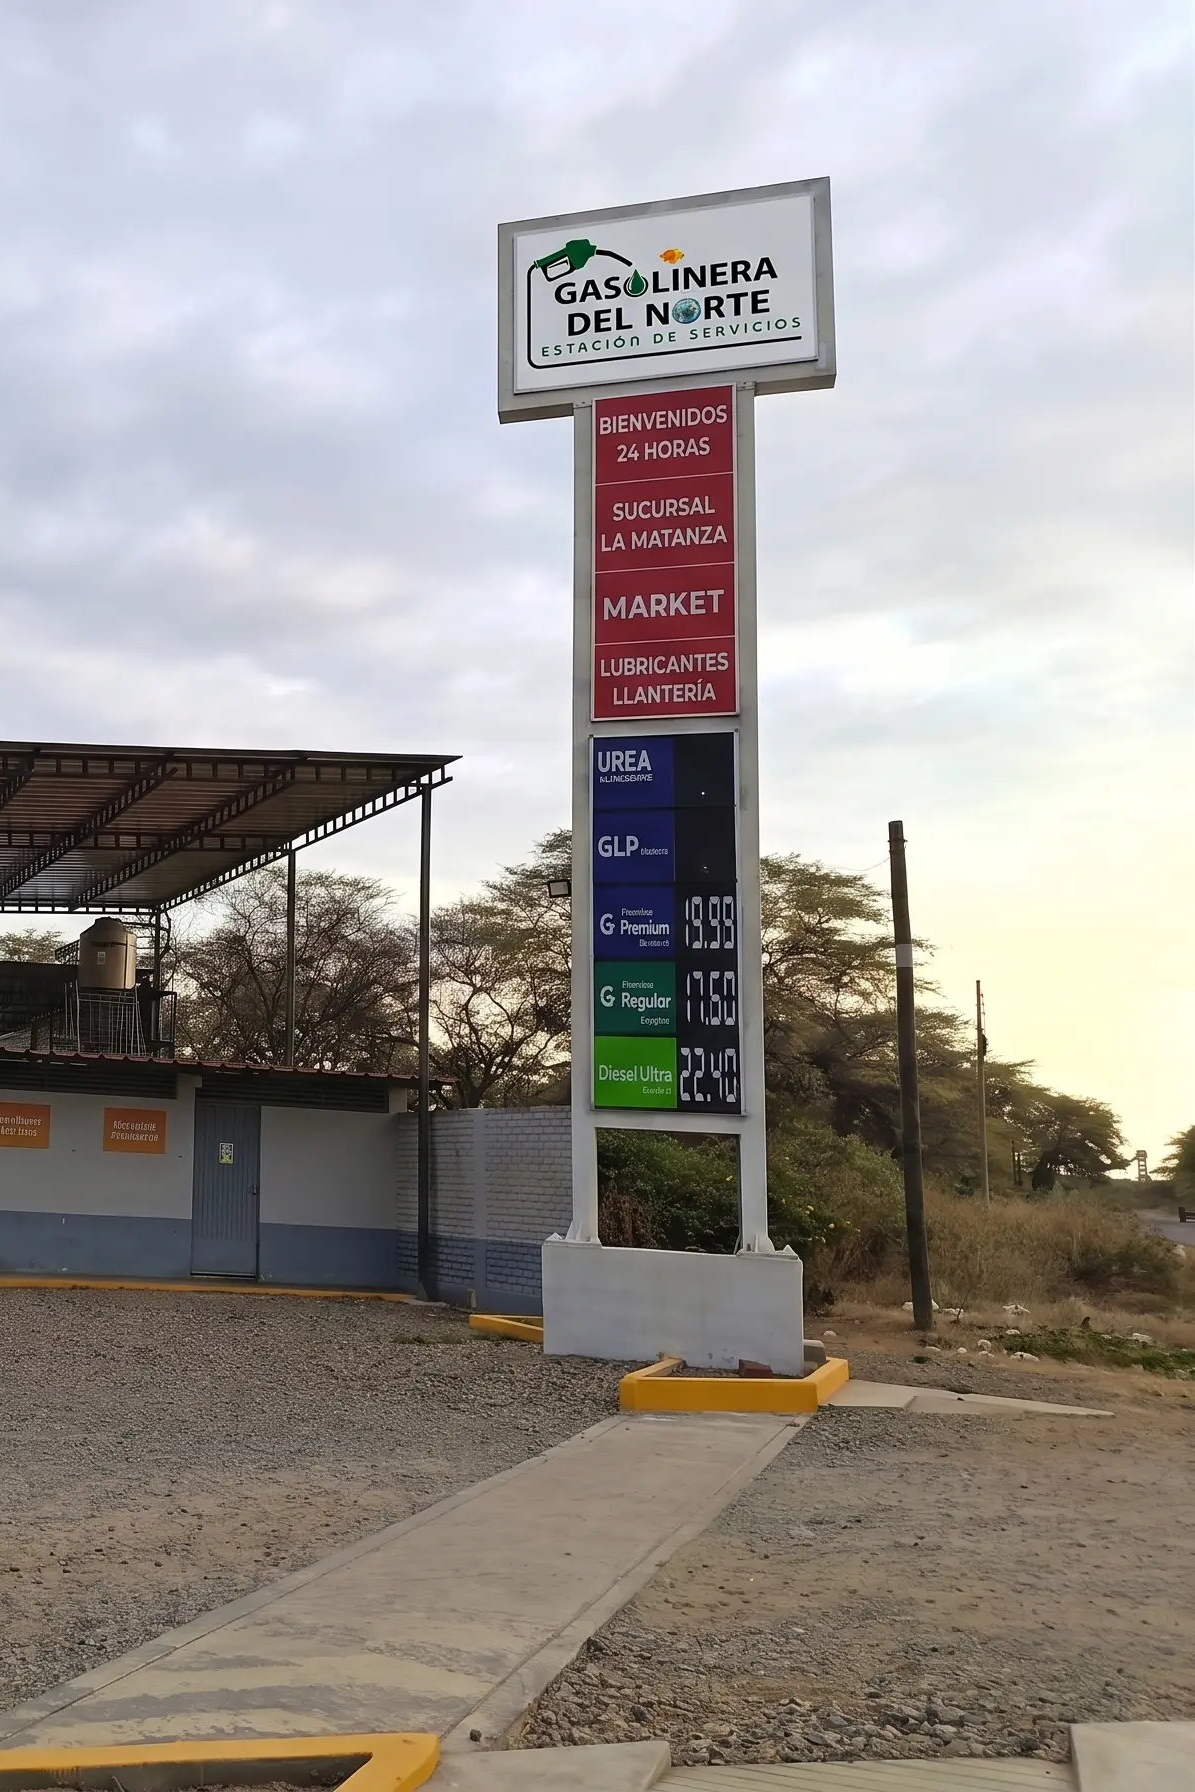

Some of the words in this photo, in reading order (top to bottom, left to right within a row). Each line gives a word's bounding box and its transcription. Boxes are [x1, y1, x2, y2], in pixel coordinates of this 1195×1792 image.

[555, 257, 778, 305] GASOLINERA
[567, 307, 633, 336] DEL
[646, 289, 771, 327] NORTE
[654, 331, 677, 345] DE
[689, 317, 802, 340] SERVICIOS
[599, 404, 728, 435] BIENVENIDOS
[616, 444, 640, 462] 24
[644, 437, 711, 460] HORAS
[612, 496, 716, 522] SUCURSAL
[601, 532, 626, 552] LA
[631, 525, 728, 549] MATANZA
[603, 589, 725, 620] MARKET
[600, 652, 729, 677] LUBRICANTES
[613, 680, 716, 705] LLANTERÍA
[597, 750, 652, 773] UREA
[598, 836, 639, 857] GLP
[620, 919, 670, 935] Premium
[621, 992, 672, 1012] Regular
[598, 1065, 638, 1082] Diesel
[640, 1065, 673, 1083] Ultra
[680, 1047, 737, 1103] 22.40
